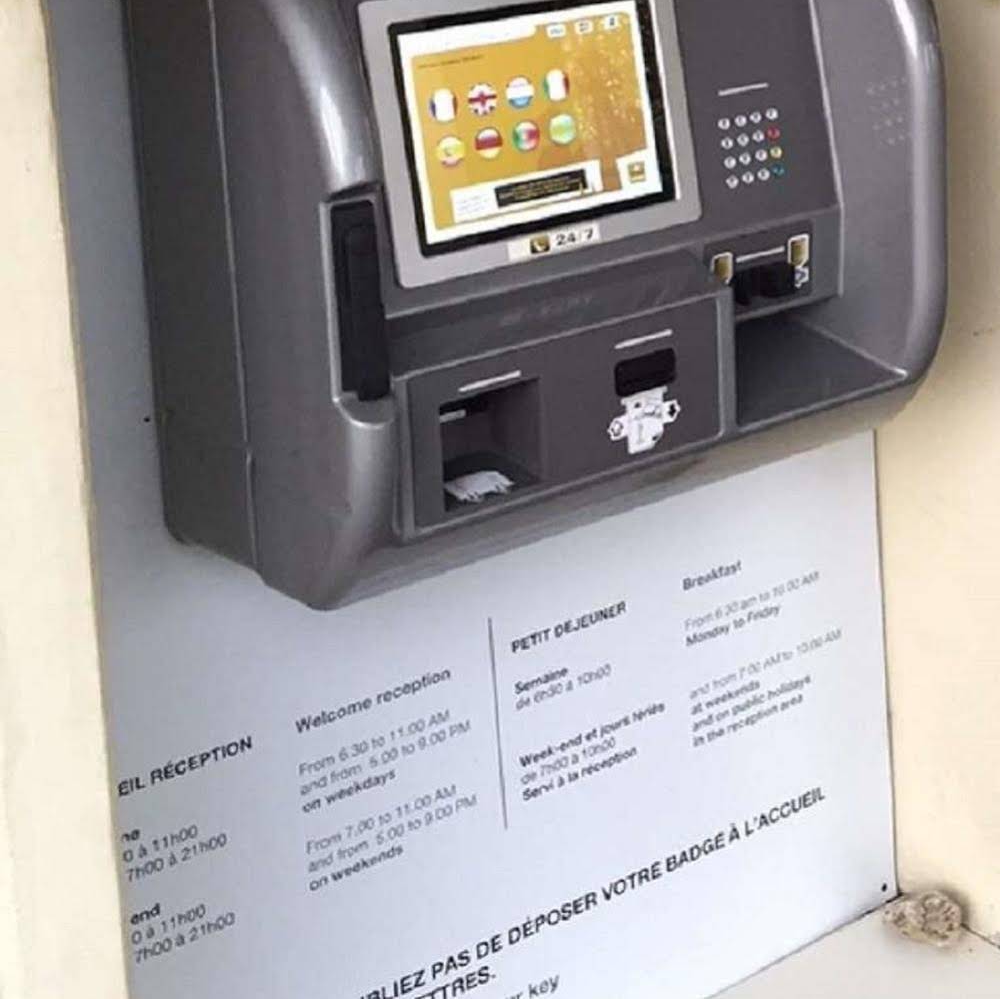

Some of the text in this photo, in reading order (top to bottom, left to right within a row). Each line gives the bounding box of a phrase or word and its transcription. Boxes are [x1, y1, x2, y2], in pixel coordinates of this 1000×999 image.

[682, 559, 743, 592] Breakfast
[511, 627, 552, 653] PETIT
[514, 667, 569, 695] Semaine
[295, 668, 452, 734] Welcome reception
[150, 735, 253, 785] RÉCEPTION
[325, 769, 396, 805] weekdays
[331, 844, 404, 882] weekends
[430, 948, 472, 981] PAS
[476, 933, 503, 961] DE
[601, 860, 664, 902] VOTRE
[665, 831, 726, 874] BADGE
[744, 786, 826, 838] L'ACCUEIL
